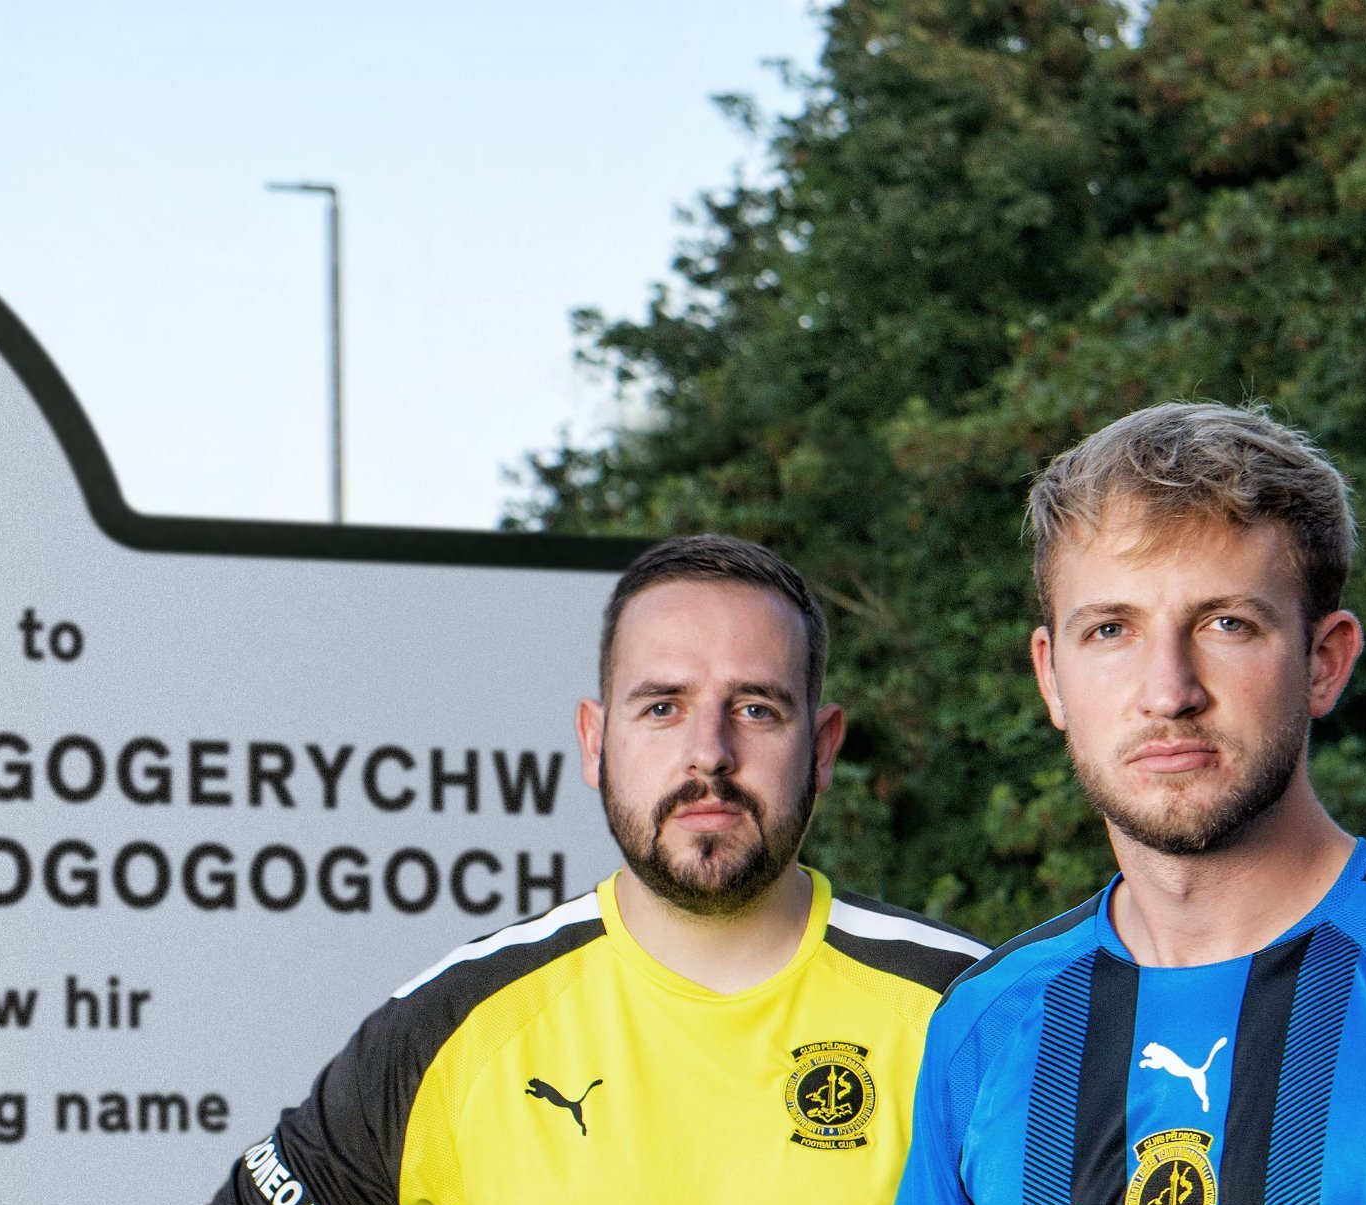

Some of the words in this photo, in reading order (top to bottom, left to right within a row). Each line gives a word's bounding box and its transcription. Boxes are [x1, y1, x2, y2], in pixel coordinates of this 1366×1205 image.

[19, 609, 84, 662] to
[66, 976, 150, 1028] hir
[57, 1093, 230, 1133] name
[800, 1138, 837, 1149] FOOTBALL
